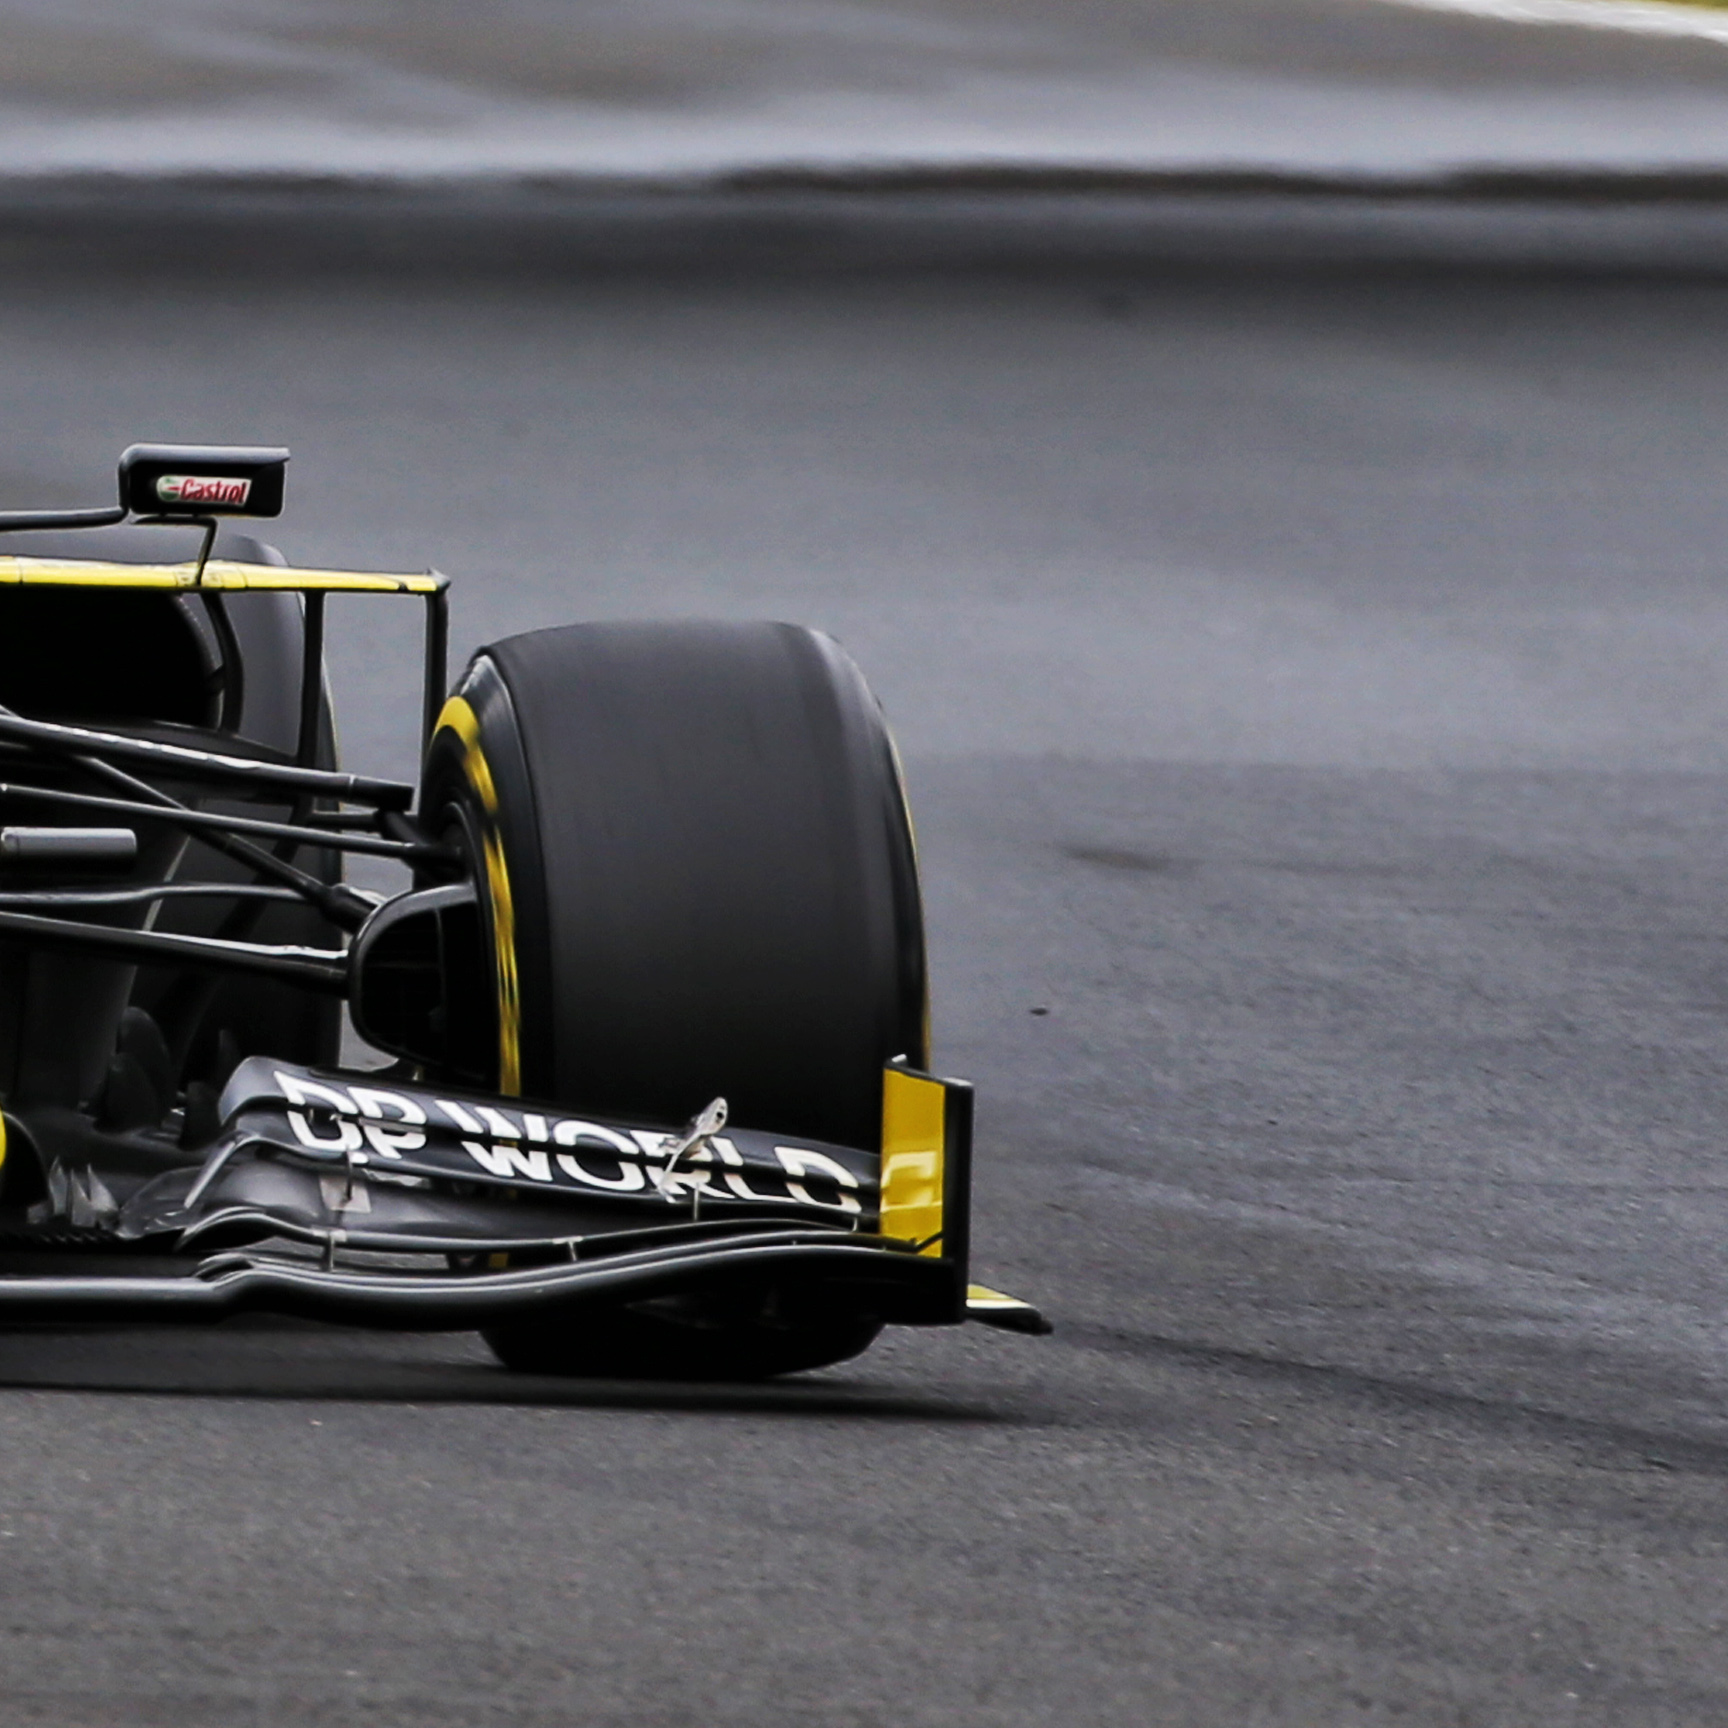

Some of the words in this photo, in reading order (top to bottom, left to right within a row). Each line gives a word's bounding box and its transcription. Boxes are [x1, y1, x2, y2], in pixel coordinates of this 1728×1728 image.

[180, 477, 247, 504] Castrol
[274, 1070, 427, 1160] DP
[434, 1099, 862, 1214] WORLD
